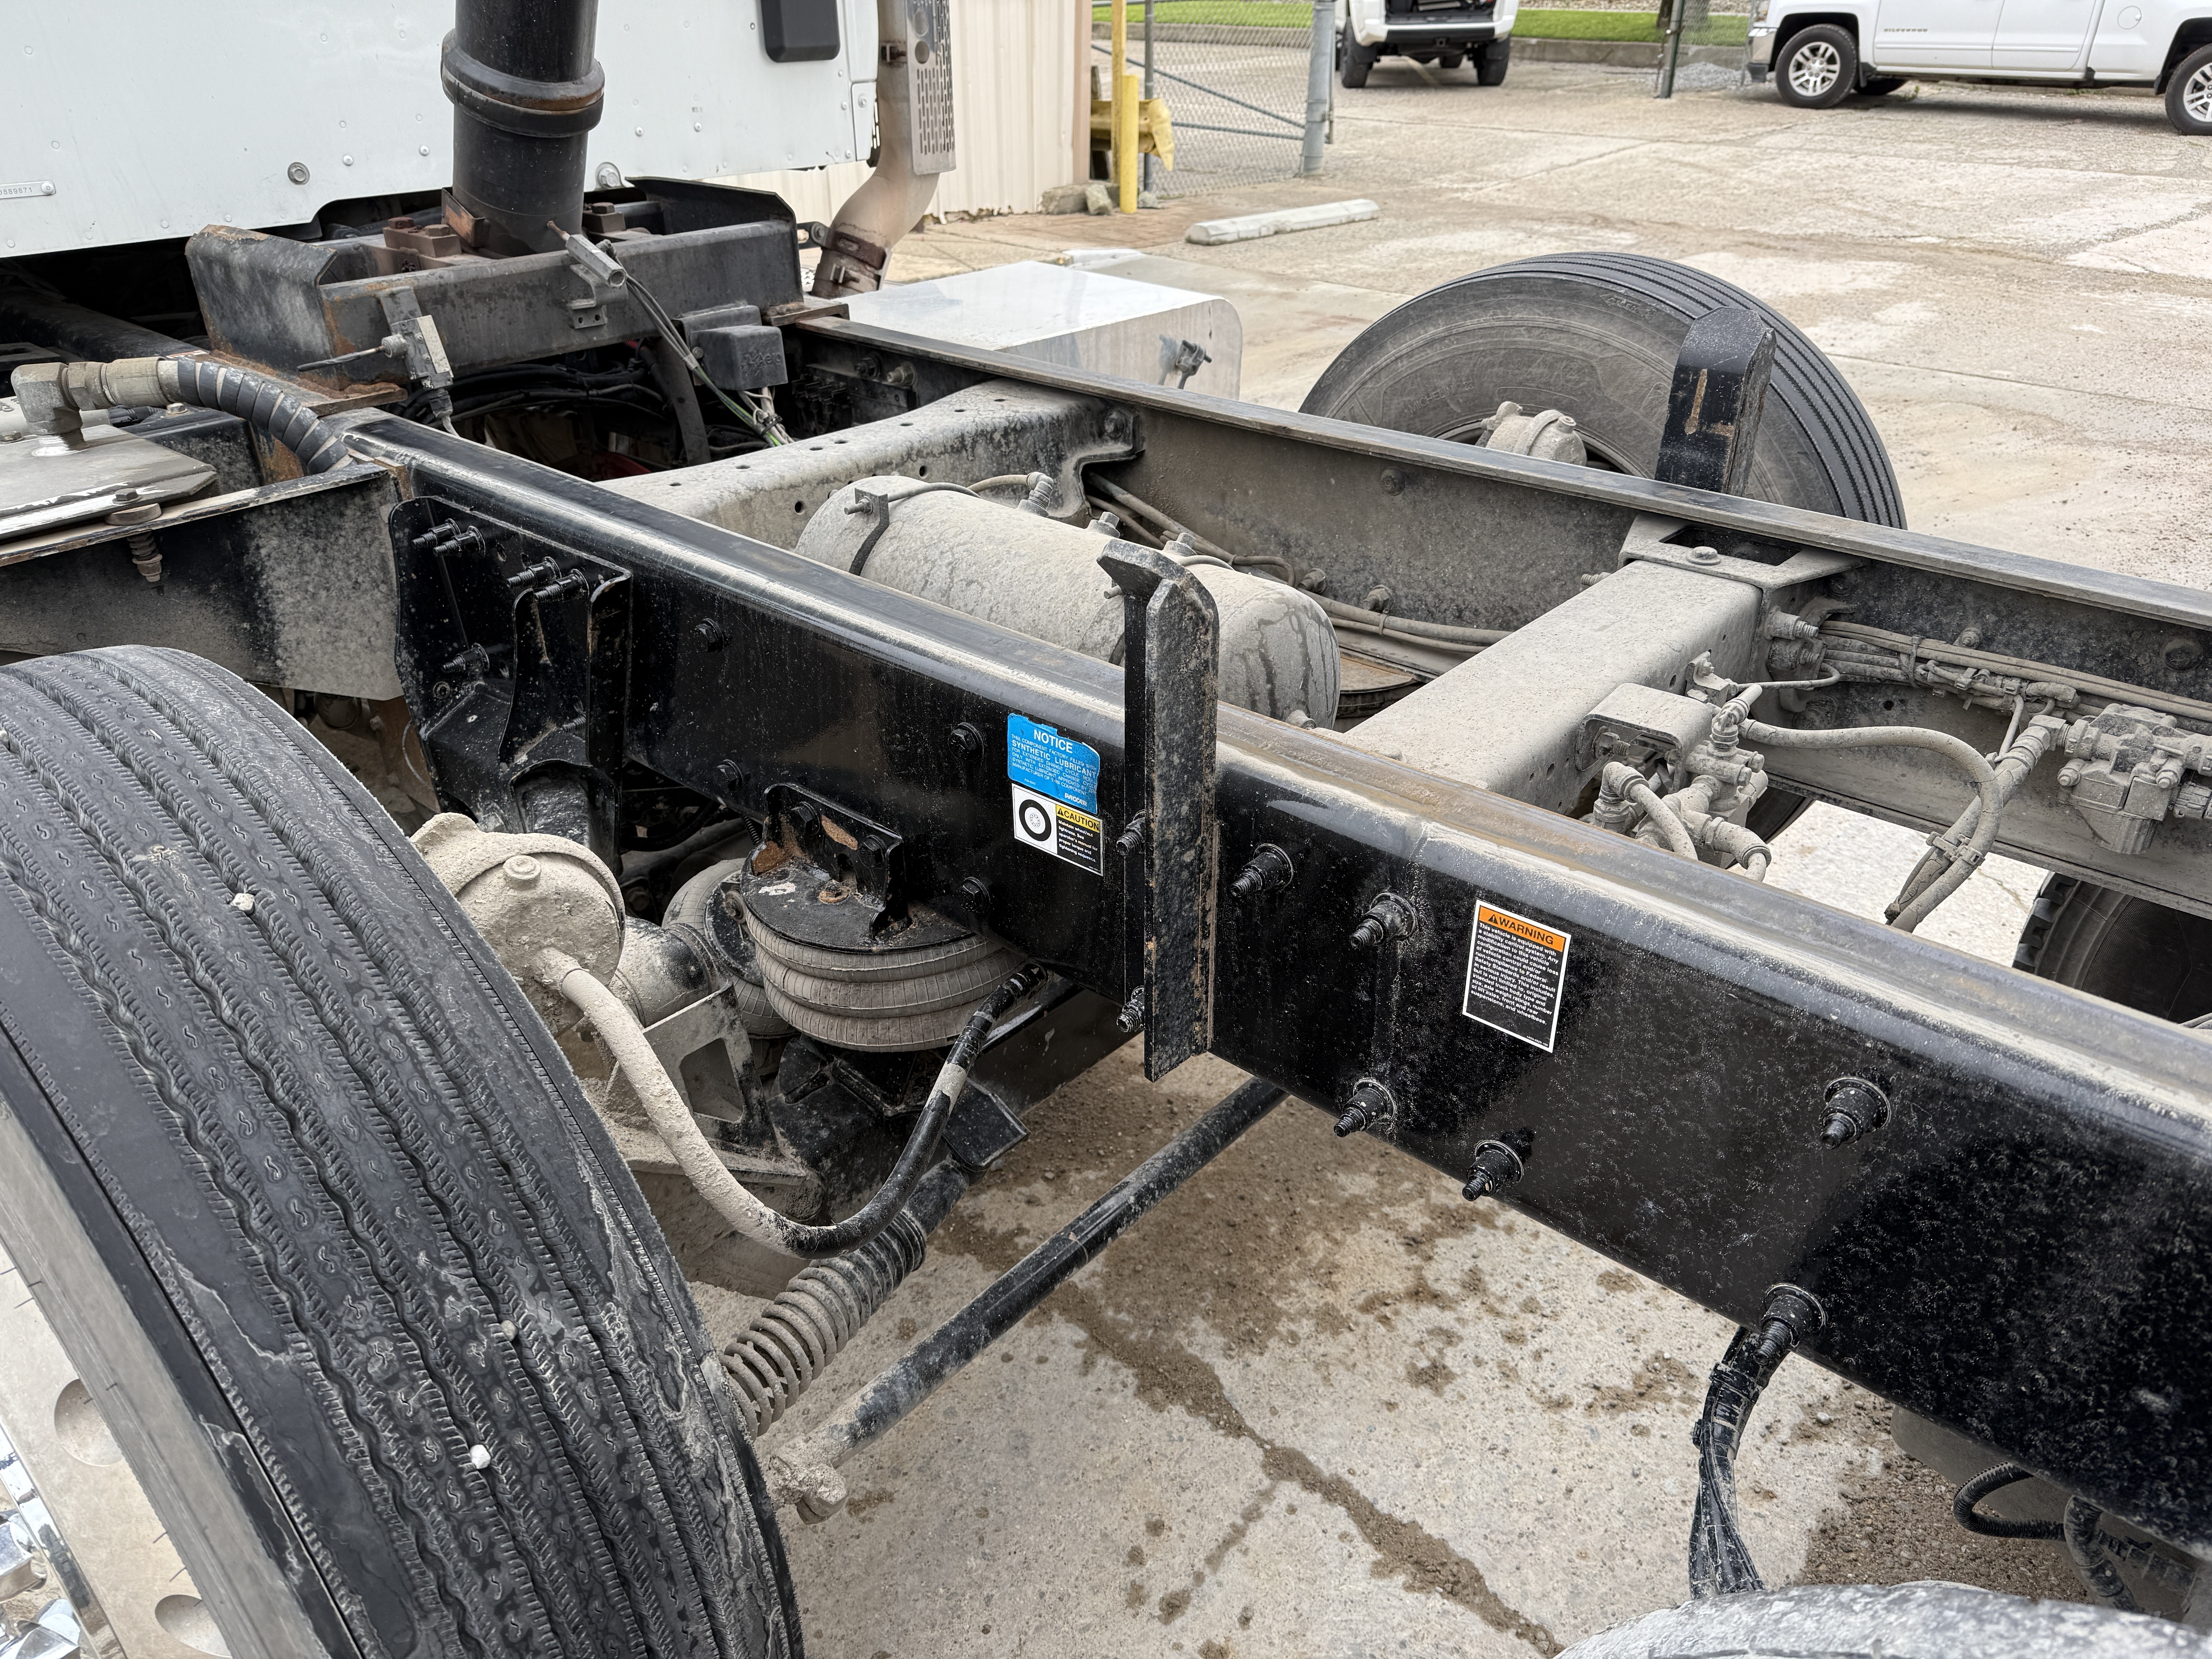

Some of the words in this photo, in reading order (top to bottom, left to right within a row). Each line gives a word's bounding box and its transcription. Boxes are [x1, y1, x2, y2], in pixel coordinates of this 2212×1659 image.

[1408, 385, 1456, 414] MICHELIN
[1022, 738, 1047, 751] COMPONENT
[1049, 749, 1068, 759] FACTORY
[1070, 757, 1084, 766] FILLED
[1034, 729, 1073, 754] NOTICE
[1012, 739, 1050, 760] SYNTHETIC
[1054, 756, 1096, 778] LUBRICANT
[1012, 762, 1043, 778] MANUFACTURER
[1012, 757, 1033, 769] SYNTHETIC
[1035, 766, 1056, 778] LUBRICANT
[1058, 775, 1080, 787] APPROVED
[1022, 750, 1044, 763] EXTENDED
[1046, 760, 1063, 771] CHANGE
[1038, 762, 1060, 774] EXTENDED
[1062, 772, 1080, 783] CHANGE
[1064, 792, 1087, 806] PACCAR
[1058, 819, 1074, 829] Maintain
[1058, 825, 1076, 836] tightness.
[1064, 811, 1099, 831] CAUTION
[1058, 832, 1077, 843] operator's
[1078, 840, 1091, 848] manual
[1058, 843, 1077, 855] tightening
[1071, 843, 1084, 851] torque
[1479, 922, 1490, 931] This
[1491, 928, 1510, 938] vehicle
[1517, 938, 1543, 951] equipped
[1499, 916, 1553, 945] WARNING
[1477, 934, 1510, 950] modification
[1530, 955, 1549, 966] vehicle
[1477, 940, 1512, 957] configuration
[1513, 955, 1528, 963] could
[1529, 961, 1546, 970] cause
[1547, 967, 1558, 975] loss
[1482, 948, 1501, 958] vehicle
[1502, 956, 1522, 967] control
[1522, 964, 1541, 974] and/or
[1483, 931, 1504, 942] stability
[1504, 939, 1524, 950] control
[1525, 947, 1546, 959] system.
[1547, 955, 1559, 964] Any
[1475, 951, 1518, 971] non-compliance
[1526, 971, 1547, 983] Federal
[1475, 956, 1491, 967] Safety
[1492, 963, 1519, 978] Standards
[1520, 975, 1539, 986] and/or
[1539, 983, 1556, 993] result
[1472, 972, 1494, 985] intended
[1495, 982, 1508, 991] truck
[1509, 988, 1522, 997] body
[1523, 994, 1534, 1002] type
[1480, 965, 1499, 975] serious
[1500, 972, 1516, 983] injury.
[1518, 979, 1529, 988] This
[1530, 984, 1554, 999] includes,
[1498, 977, 1517, 989] limited
[1526, 990, 1547, 1001] original
[1470, 990, 1504, 1007] suspensions,
[1516, 1009, 1547, 1025] wheelbase.
[1472, 979, 1483, 987] size,
[1495, 988, 1512, 999] weight
[1512, 996, 1531, 1007] ratings,
[1532, 1004, 1552, 1015] number
[1485, 989, 1501, 1000] axles,
[1501, 996, 1515, 1006] front
